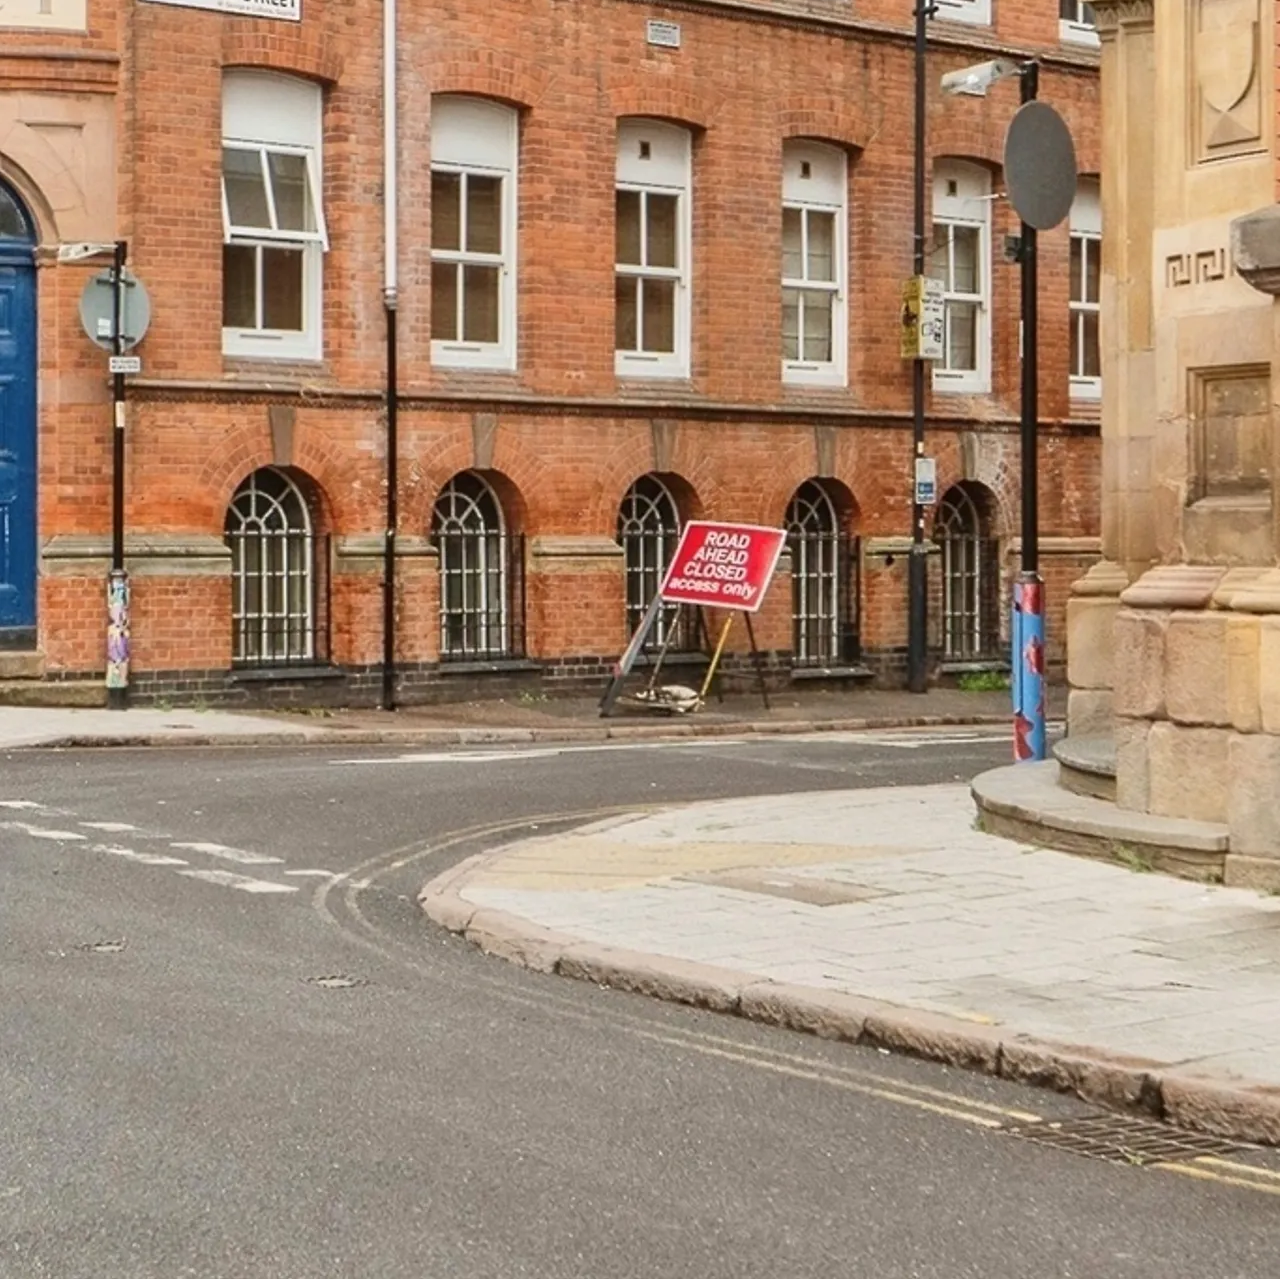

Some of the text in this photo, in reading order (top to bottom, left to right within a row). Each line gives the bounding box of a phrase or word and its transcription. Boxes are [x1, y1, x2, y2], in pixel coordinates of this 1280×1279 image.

[704, 531, 751, 549] ROAD
[693, 546, 749, 565] AHEAD
[683, 561, 747, 581] CLOSED
[669, 578, 758, 600] access only
